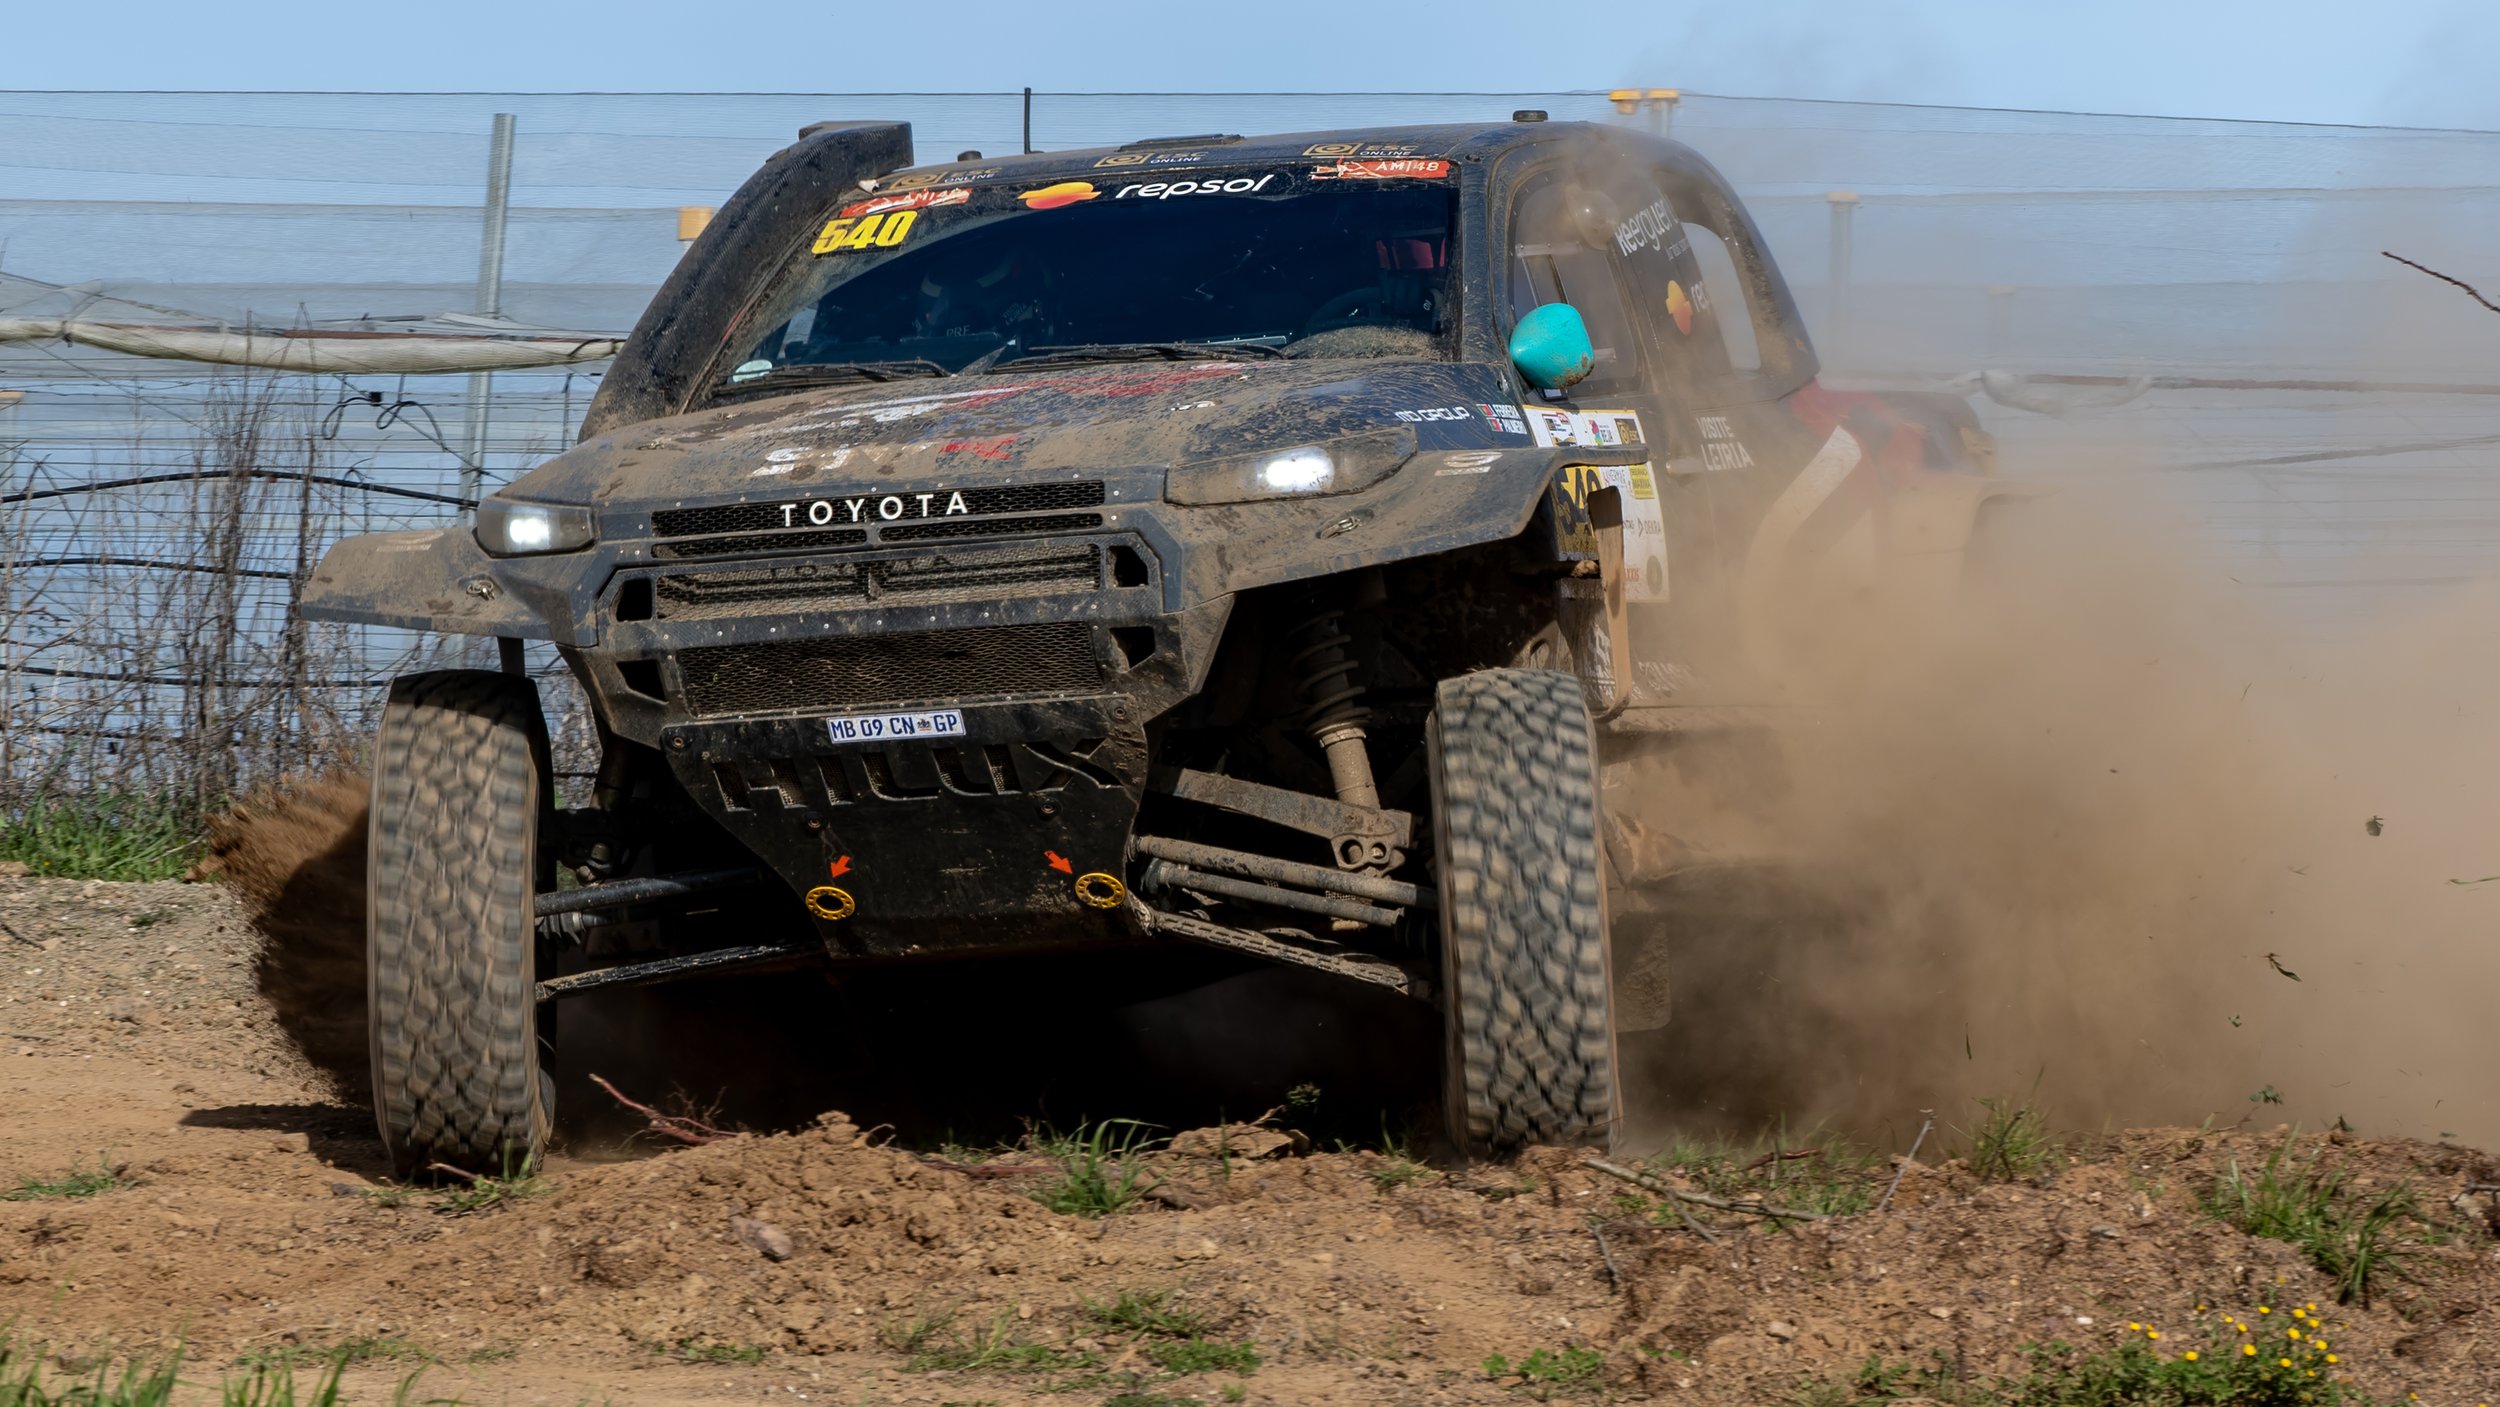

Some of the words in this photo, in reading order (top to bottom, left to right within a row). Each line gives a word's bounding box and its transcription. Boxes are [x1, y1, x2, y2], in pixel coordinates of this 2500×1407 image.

[1150, 156, 1201, 164] ONLINE
[944, 173, 995, 183] ONLINE
[1115, 174, 1274, 200] repsol
[811, 210, 918, 255] 540
[1696, 416, 1735, 439] VISITE
[1701, 441, 1755, 471] LEIRIA
[779, 491, 968, 527] TOYOTA
[831, 720, 856, 739] MB
[860, 719, 883, 737] 09
[889, 716, 915, 735] CN
[933, 714, 958, 732] GP
